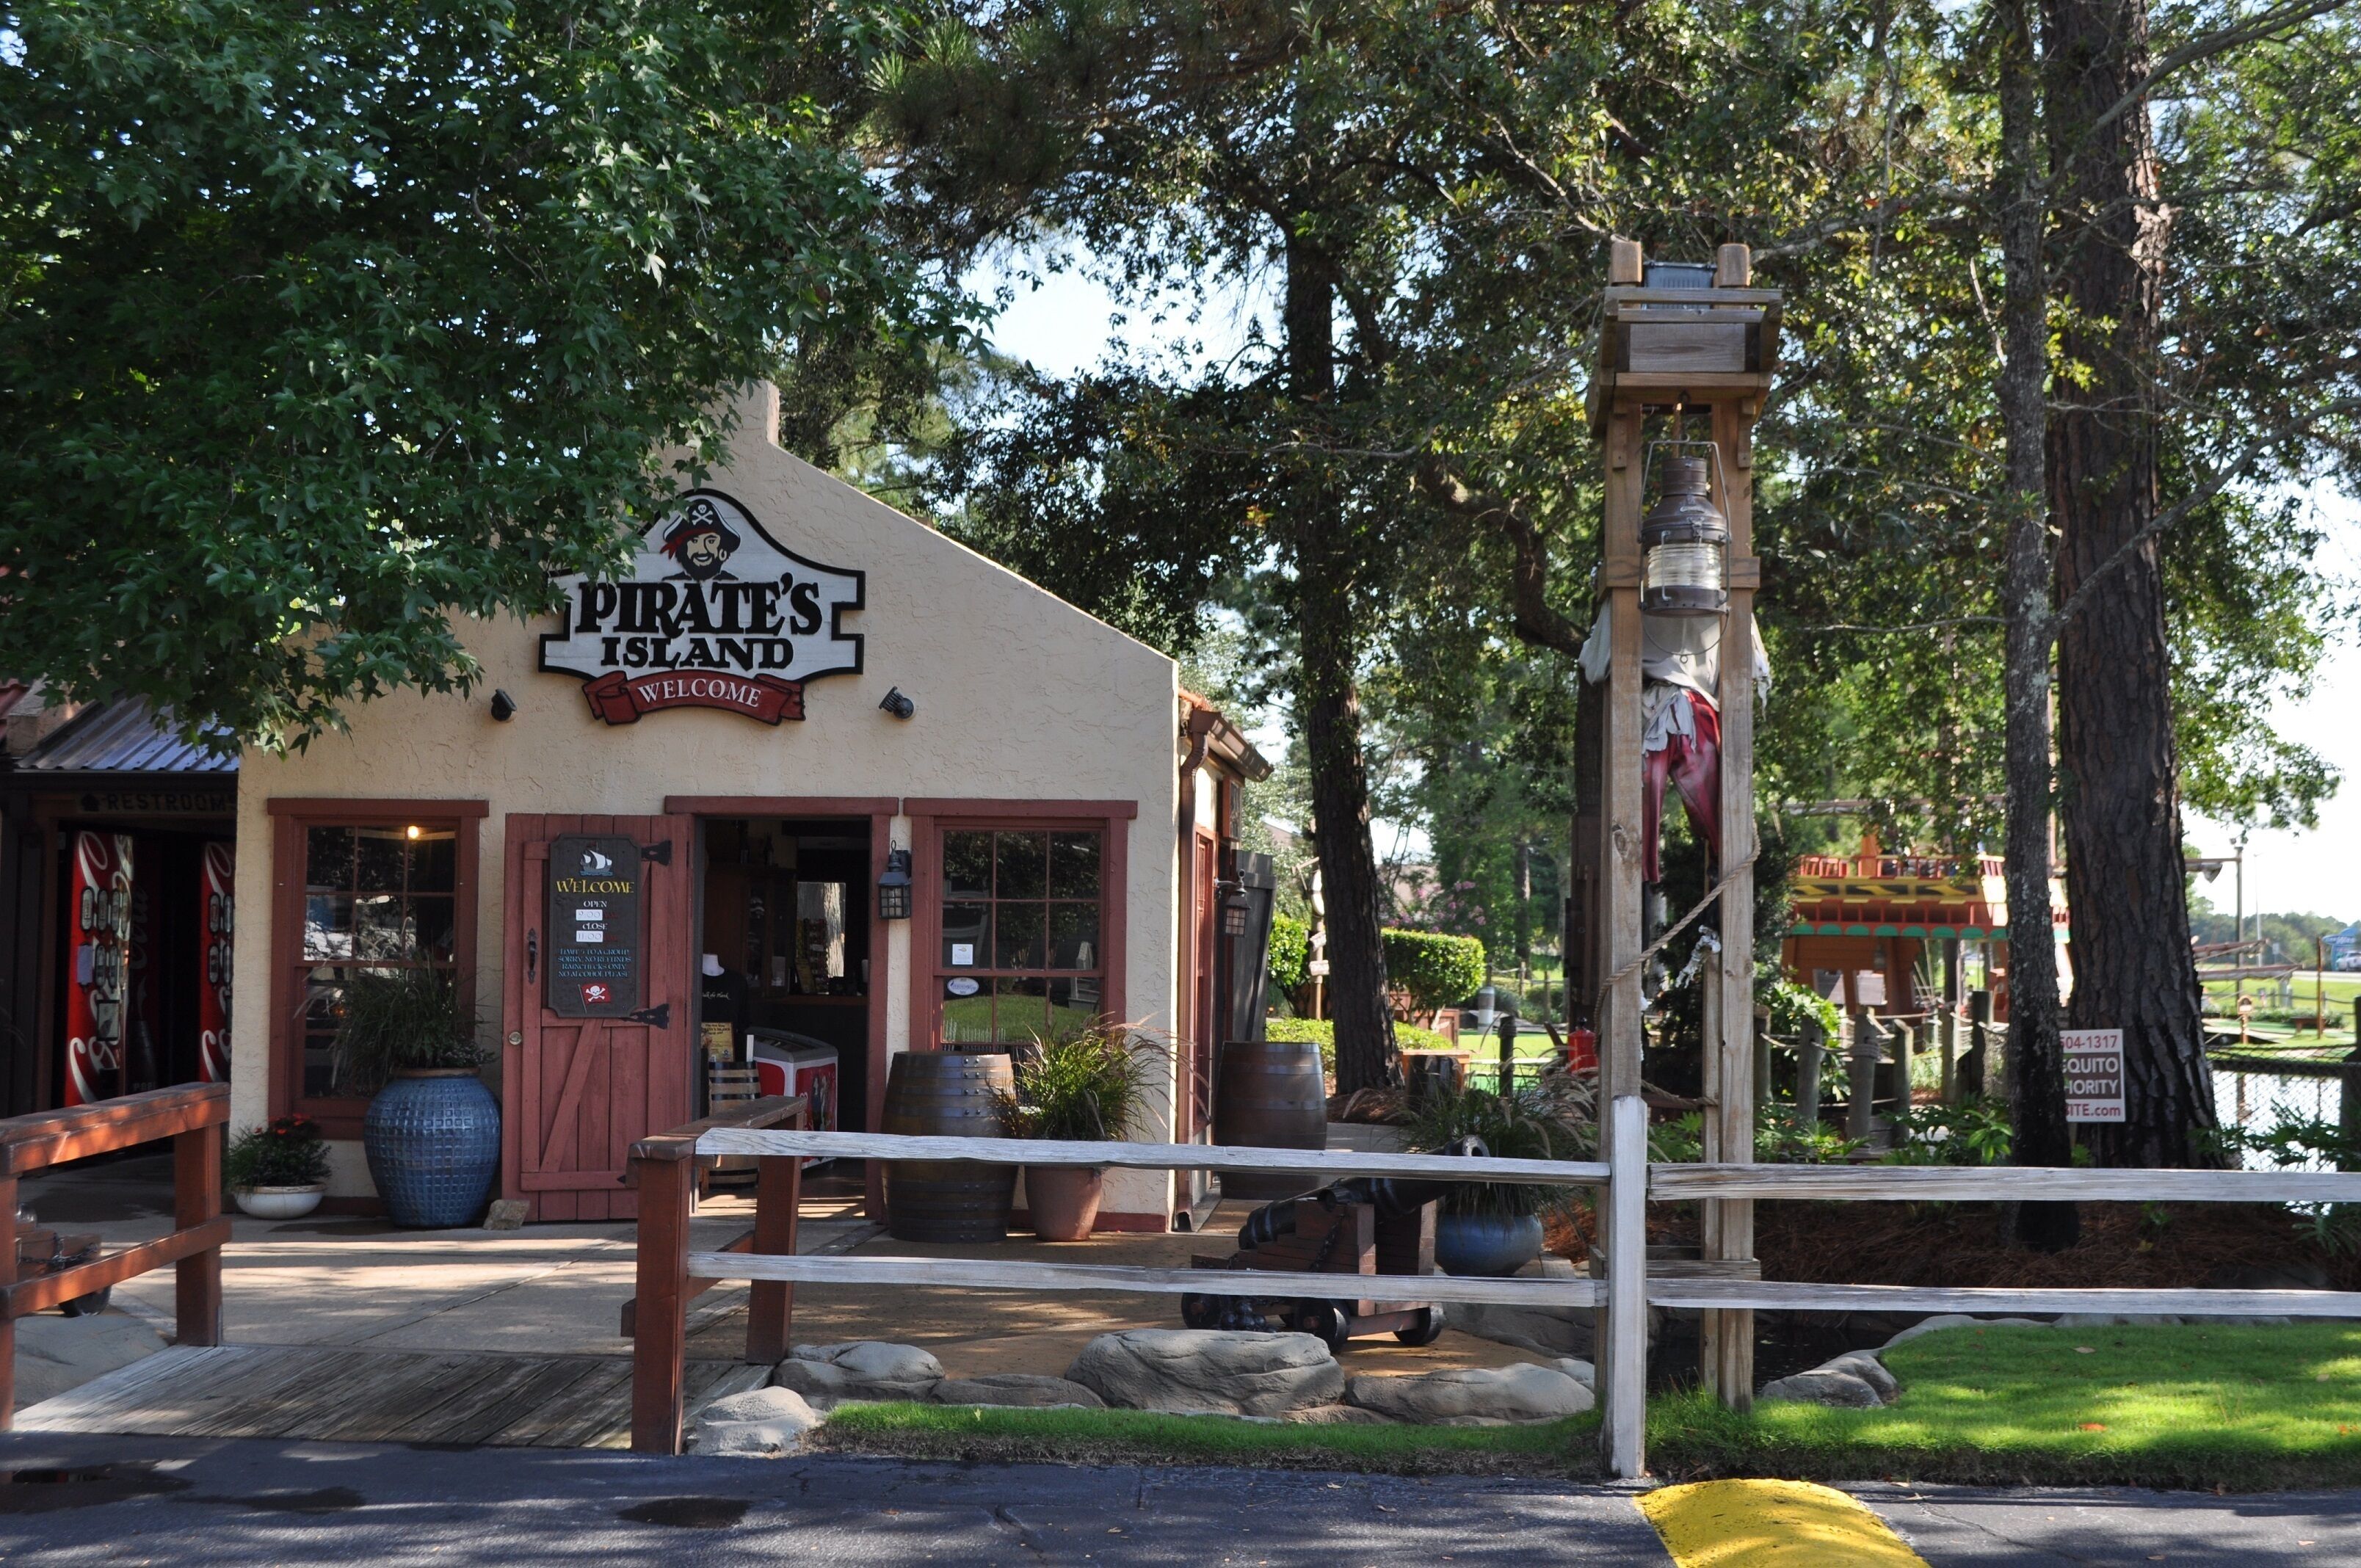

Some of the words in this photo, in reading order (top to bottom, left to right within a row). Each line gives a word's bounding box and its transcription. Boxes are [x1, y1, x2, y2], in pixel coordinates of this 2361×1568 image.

[575, 573, 823, 639] PIRATE'S
[601, 637, 794, 671] ISLAND
[637, 678, 762, 708] WELCOME
[556, 878, 634, 893] WELCOME
[582, 922, 608, 930] CLOSE
